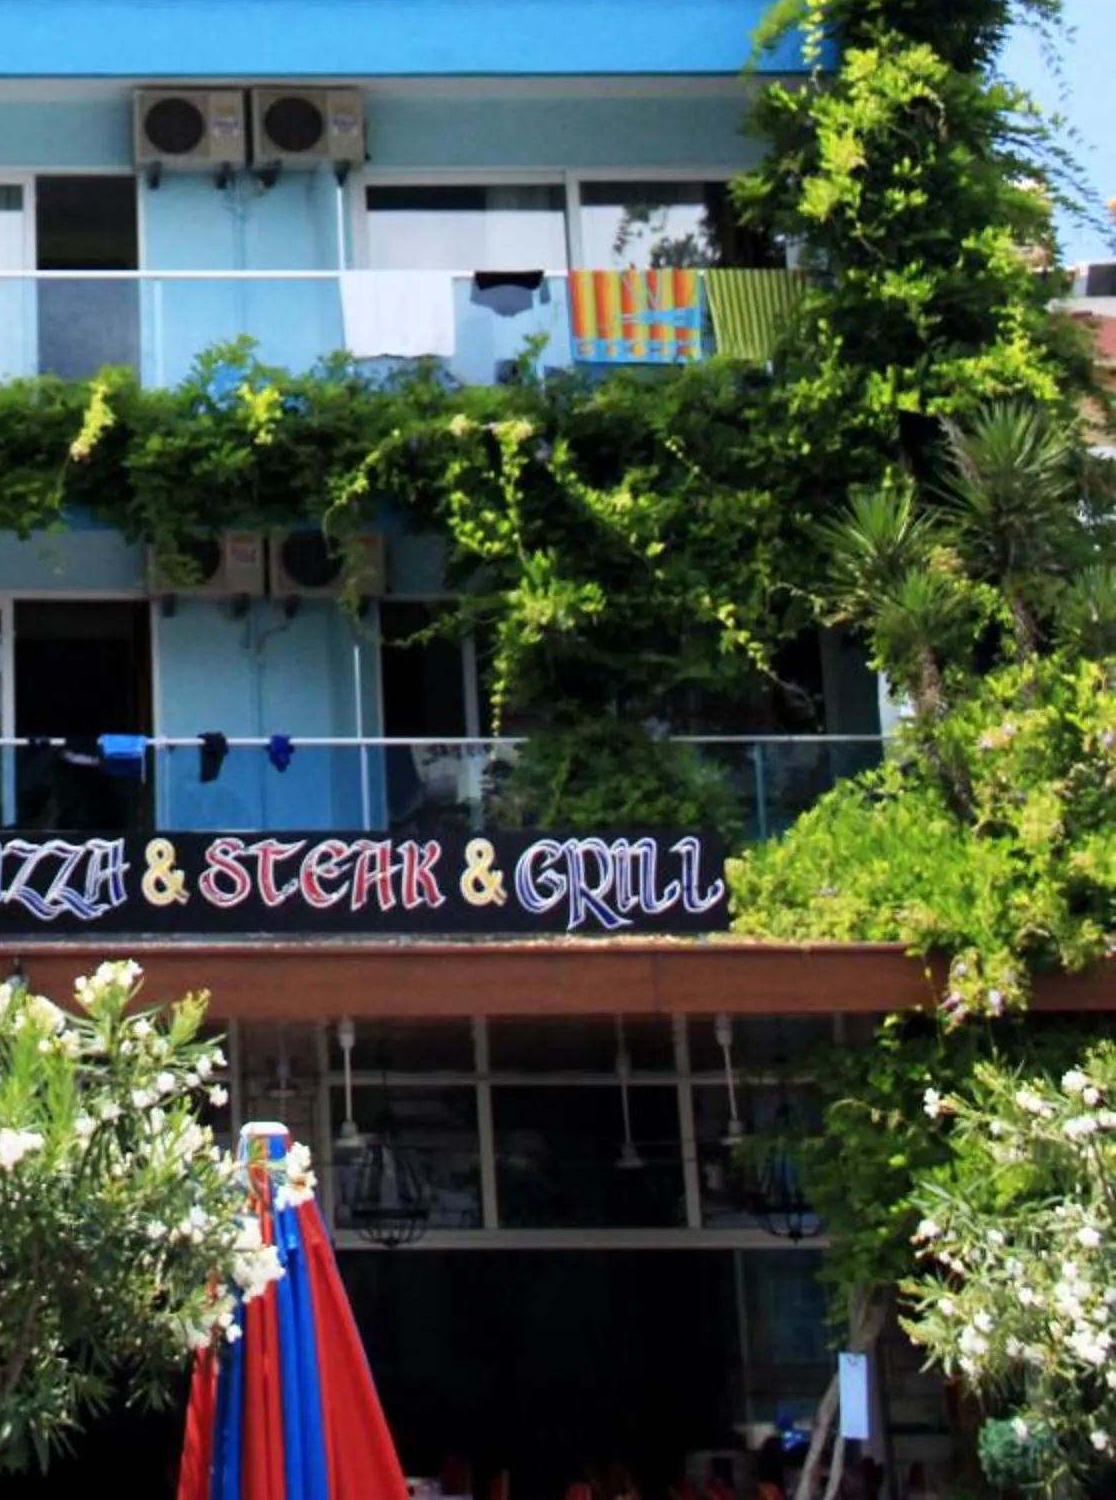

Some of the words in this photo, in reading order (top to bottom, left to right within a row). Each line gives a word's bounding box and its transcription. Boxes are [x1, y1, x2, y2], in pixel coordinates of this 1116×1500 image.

[141, 838, 188, 904] &
[198, 838, 445, 912] STEAK
[460, 837, 507, 906] &
[514, 835, 724, 931] GRILL
